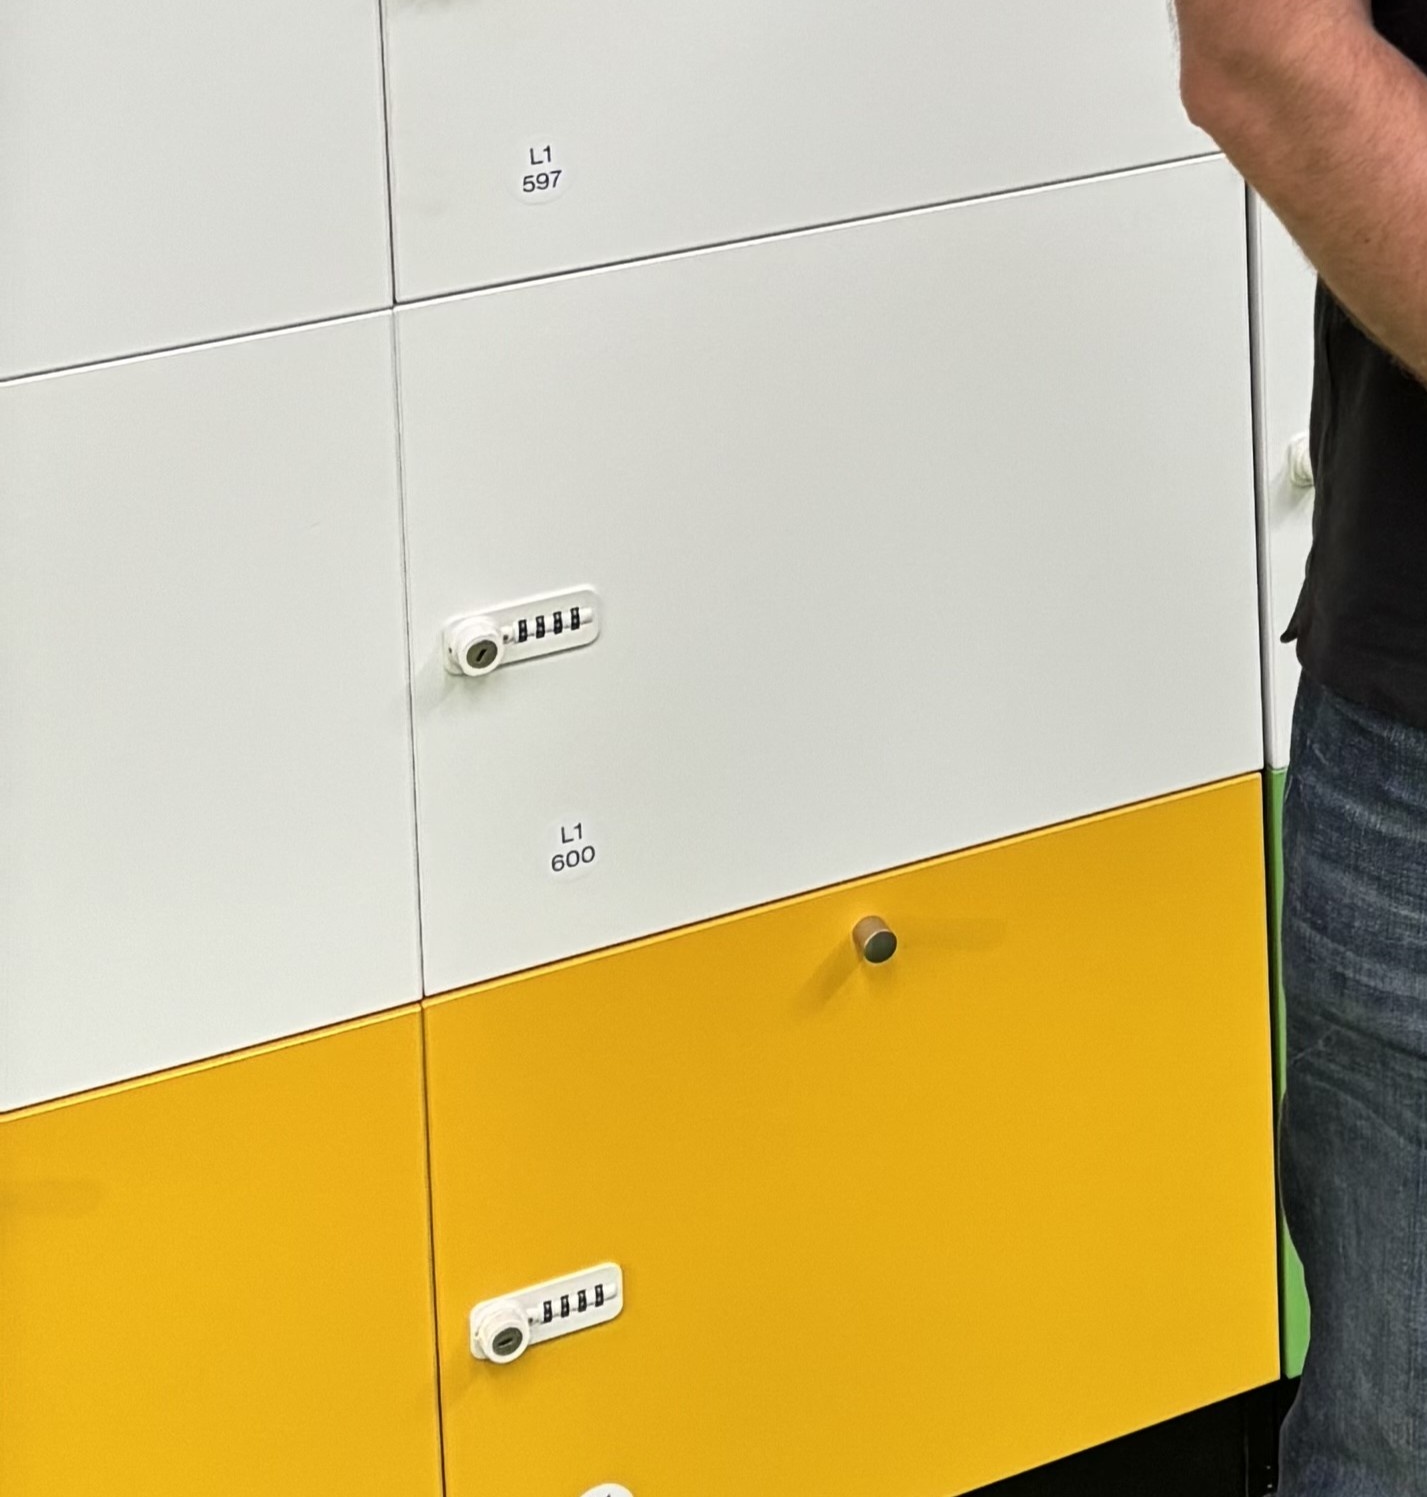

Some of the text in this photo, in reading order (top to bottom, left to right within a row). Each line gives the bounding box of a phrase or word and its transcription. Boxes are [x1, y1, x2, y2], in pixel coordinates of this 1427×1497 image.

[529, 144, 551, 165] L1
[523, 169, 562, 192] 597
[561, 822, 582, 844] L1
[551, 845, 596, 872] 600
